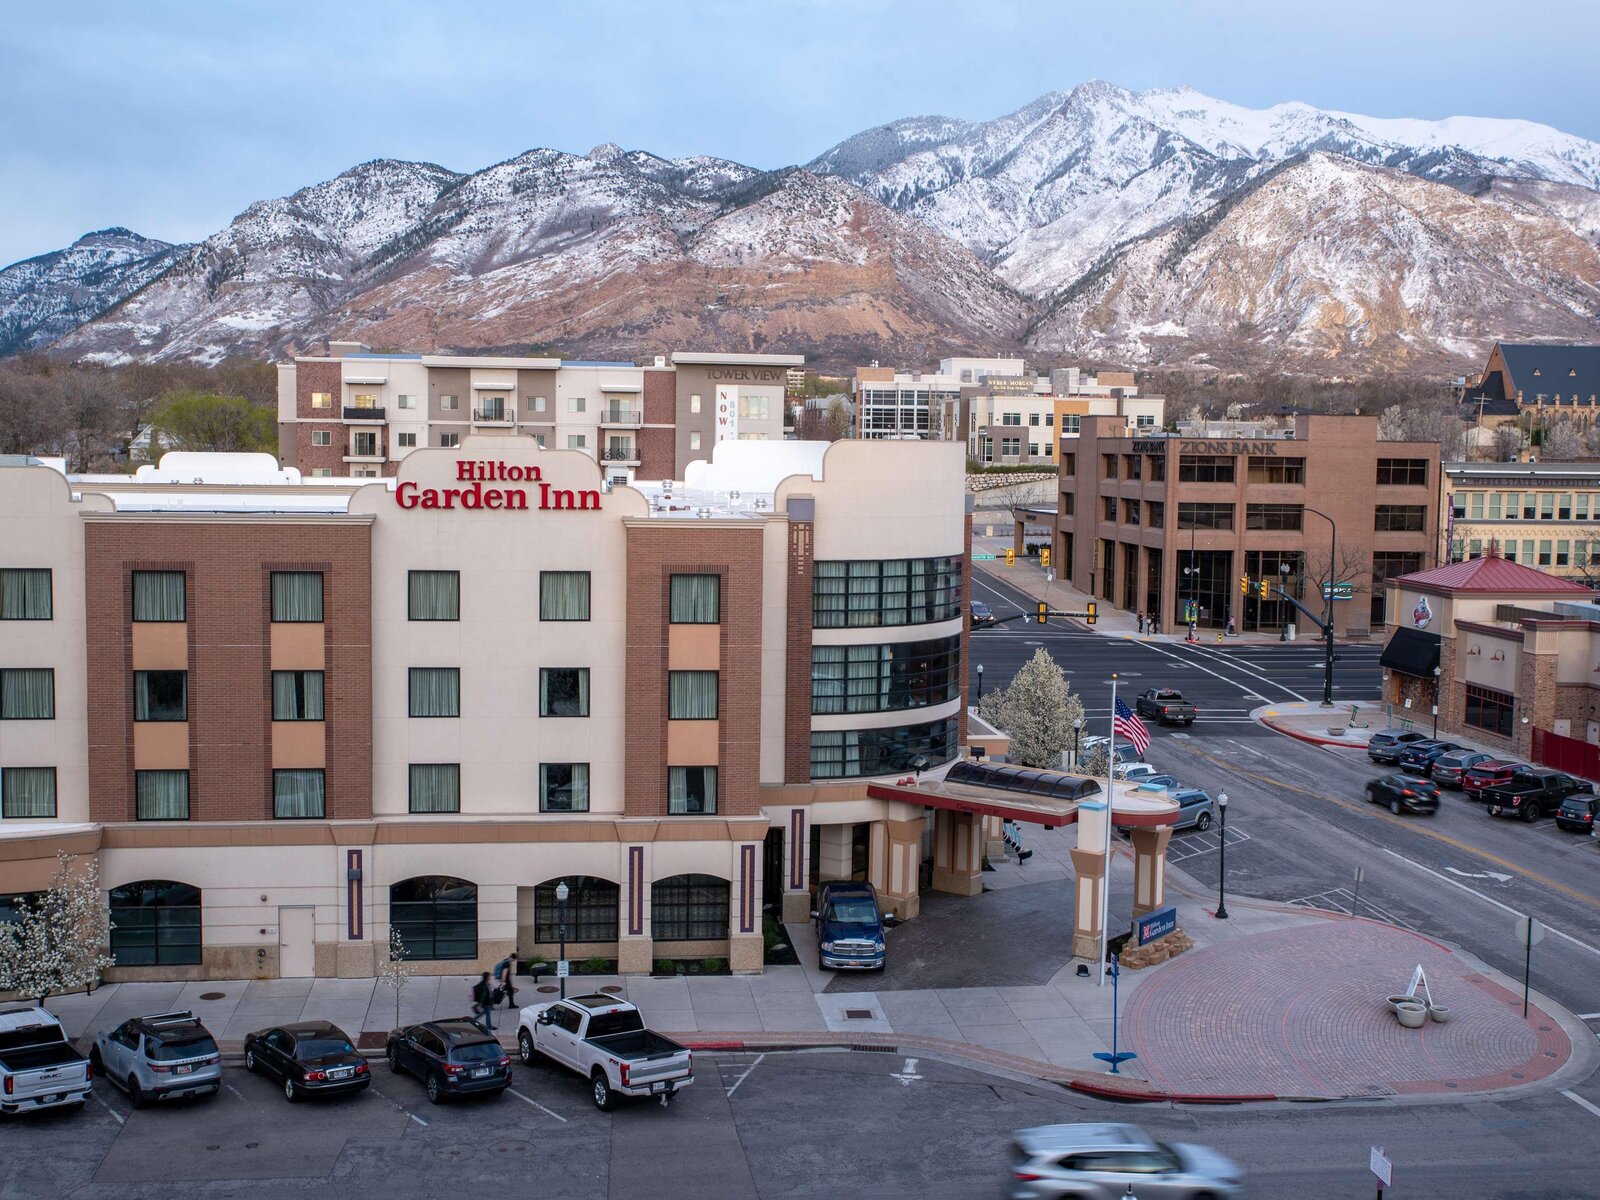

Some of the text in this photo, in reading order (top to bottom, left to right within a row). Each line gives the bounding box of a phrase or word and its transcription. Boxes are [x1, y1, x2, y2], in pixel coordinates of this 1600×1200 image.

[705, 369, 782, 381] TOWER VIEW
[719, 391, 728, 426] NOW
[1180, 441, 1278, 456] ZIONS BANK
[456, 461, 543, 481] Hilton
[1536, 479, 1592, 487] UNIVERSITY
[395, 482, 602, 511] Garden Inn
[1150, 924, 1166, 937] Garden
[40, 1072, 63, 1080] GMC
